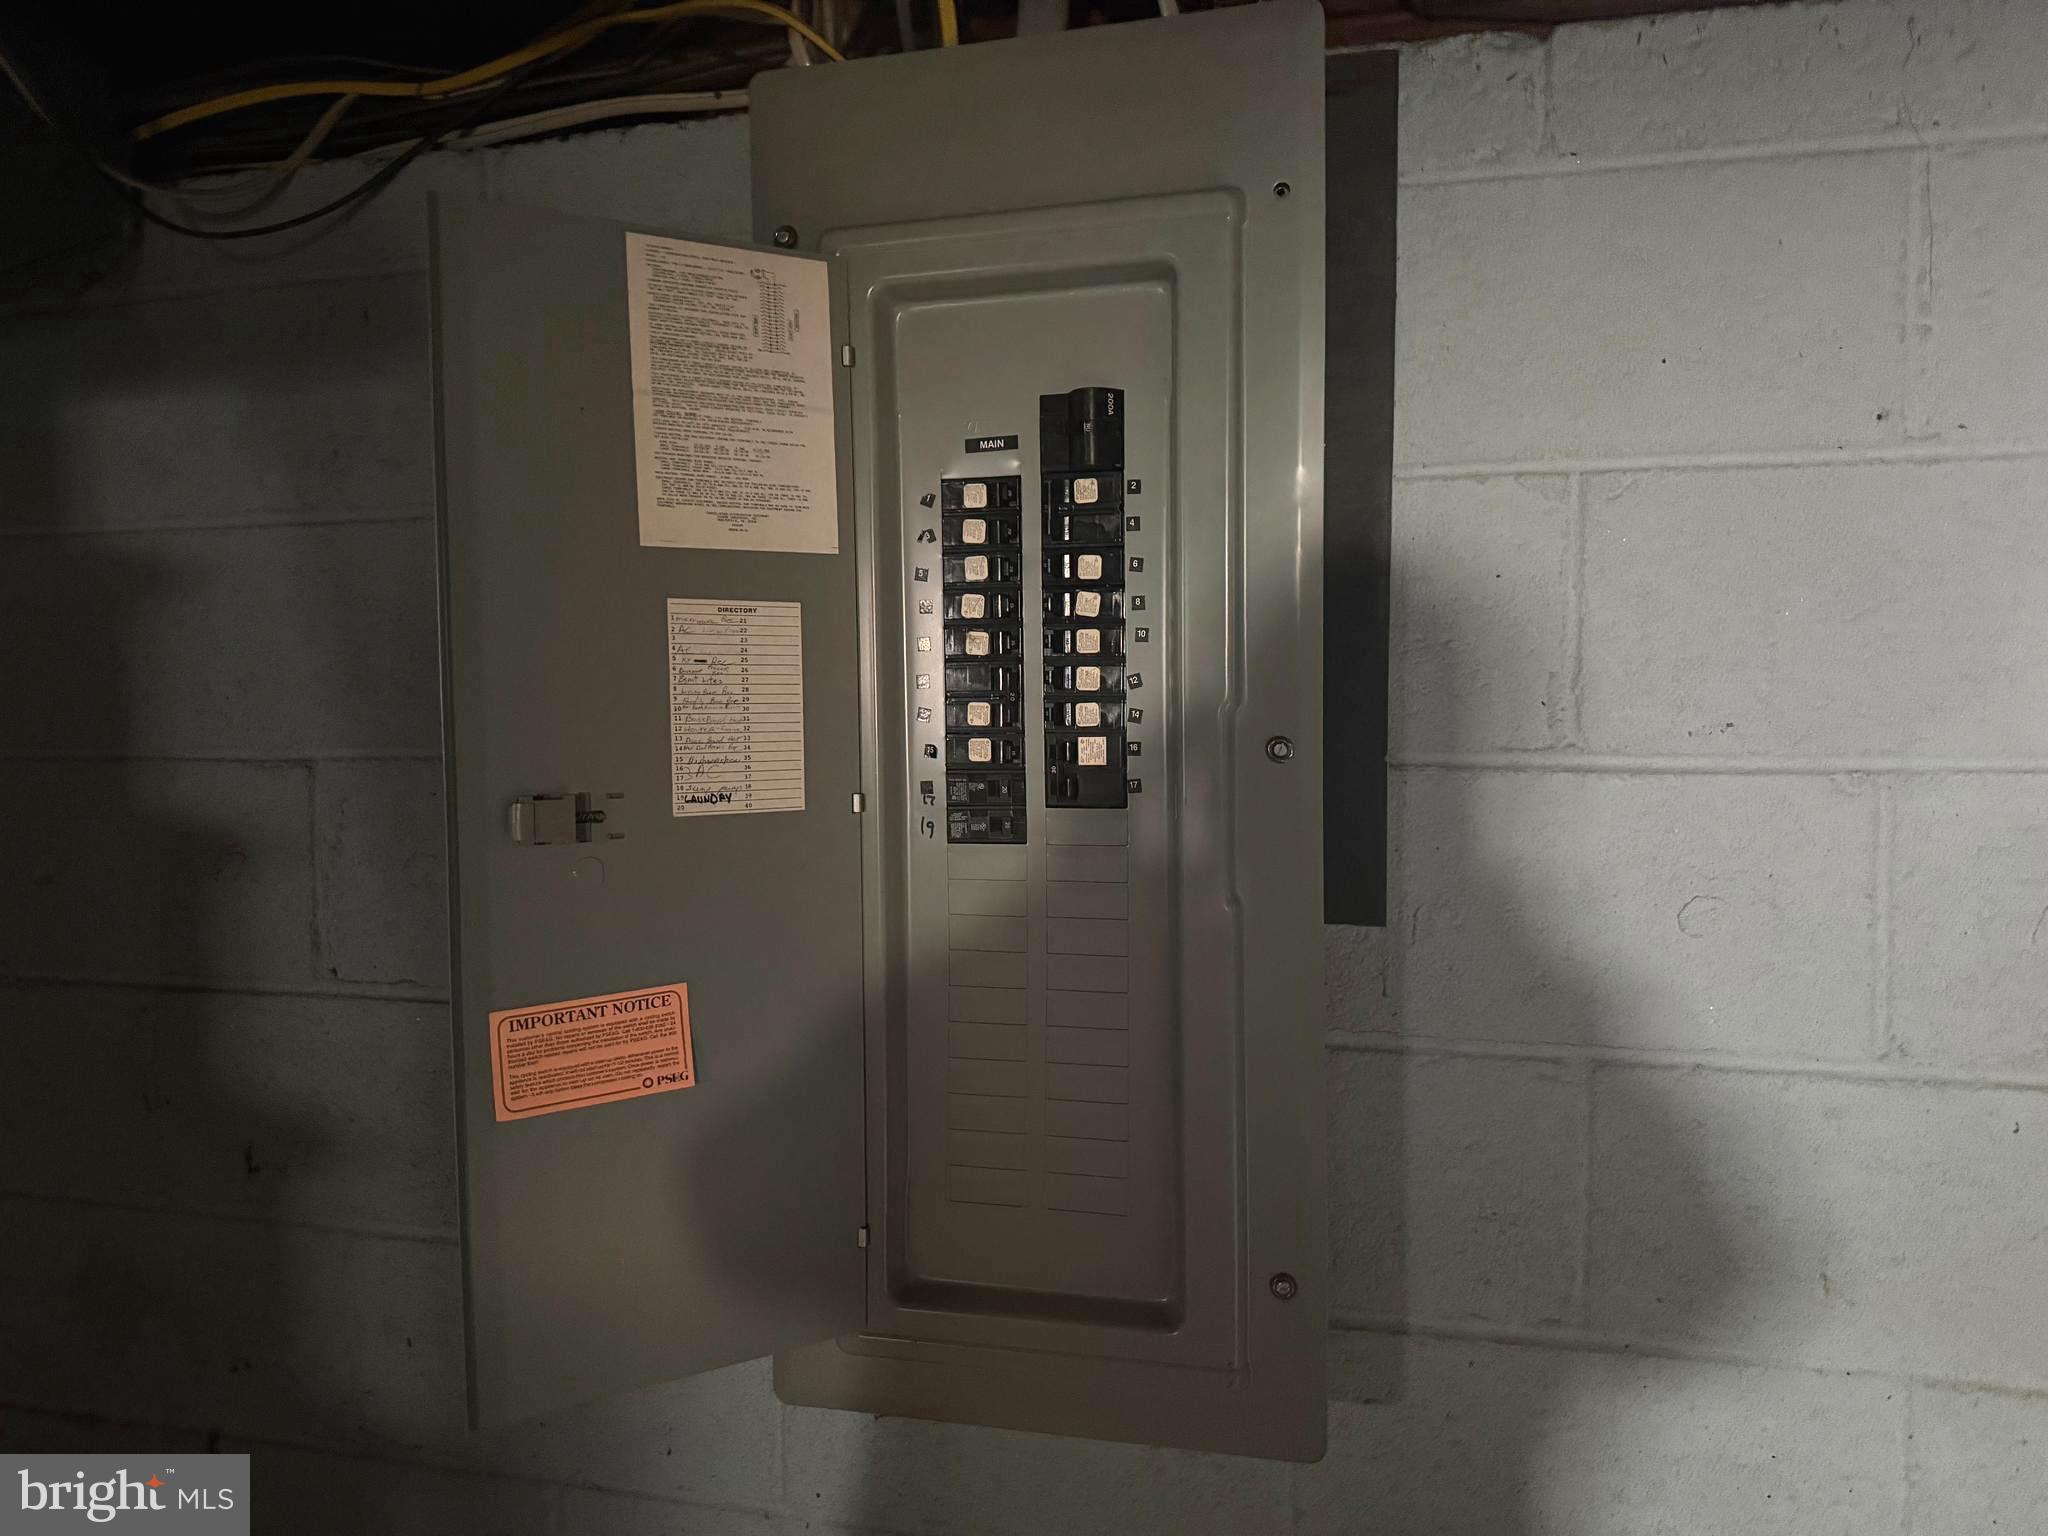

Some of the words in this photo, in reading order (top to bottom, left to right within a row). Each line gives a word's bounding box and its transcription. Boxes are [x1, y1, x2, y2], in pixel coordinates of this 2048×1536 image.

[979, 439, 1005, 449] MAIN
[1130, 481, 1137, 489] 2
[717, 606, 758, 614] DIRECTORY
[1129, 676, 1139, 684] 12
[1131, 710, 1140, 718] 14
[1129, 743, 1138, 751] 16
[1129, 781, 1138, 789] 17
[920, 815, 935, 839] 19
[508, 1004, 608, 1033] IMPORTANT
[613, 994, 672, 1014] NOTICE
[657, 1071, 689, 1086] PSEG
